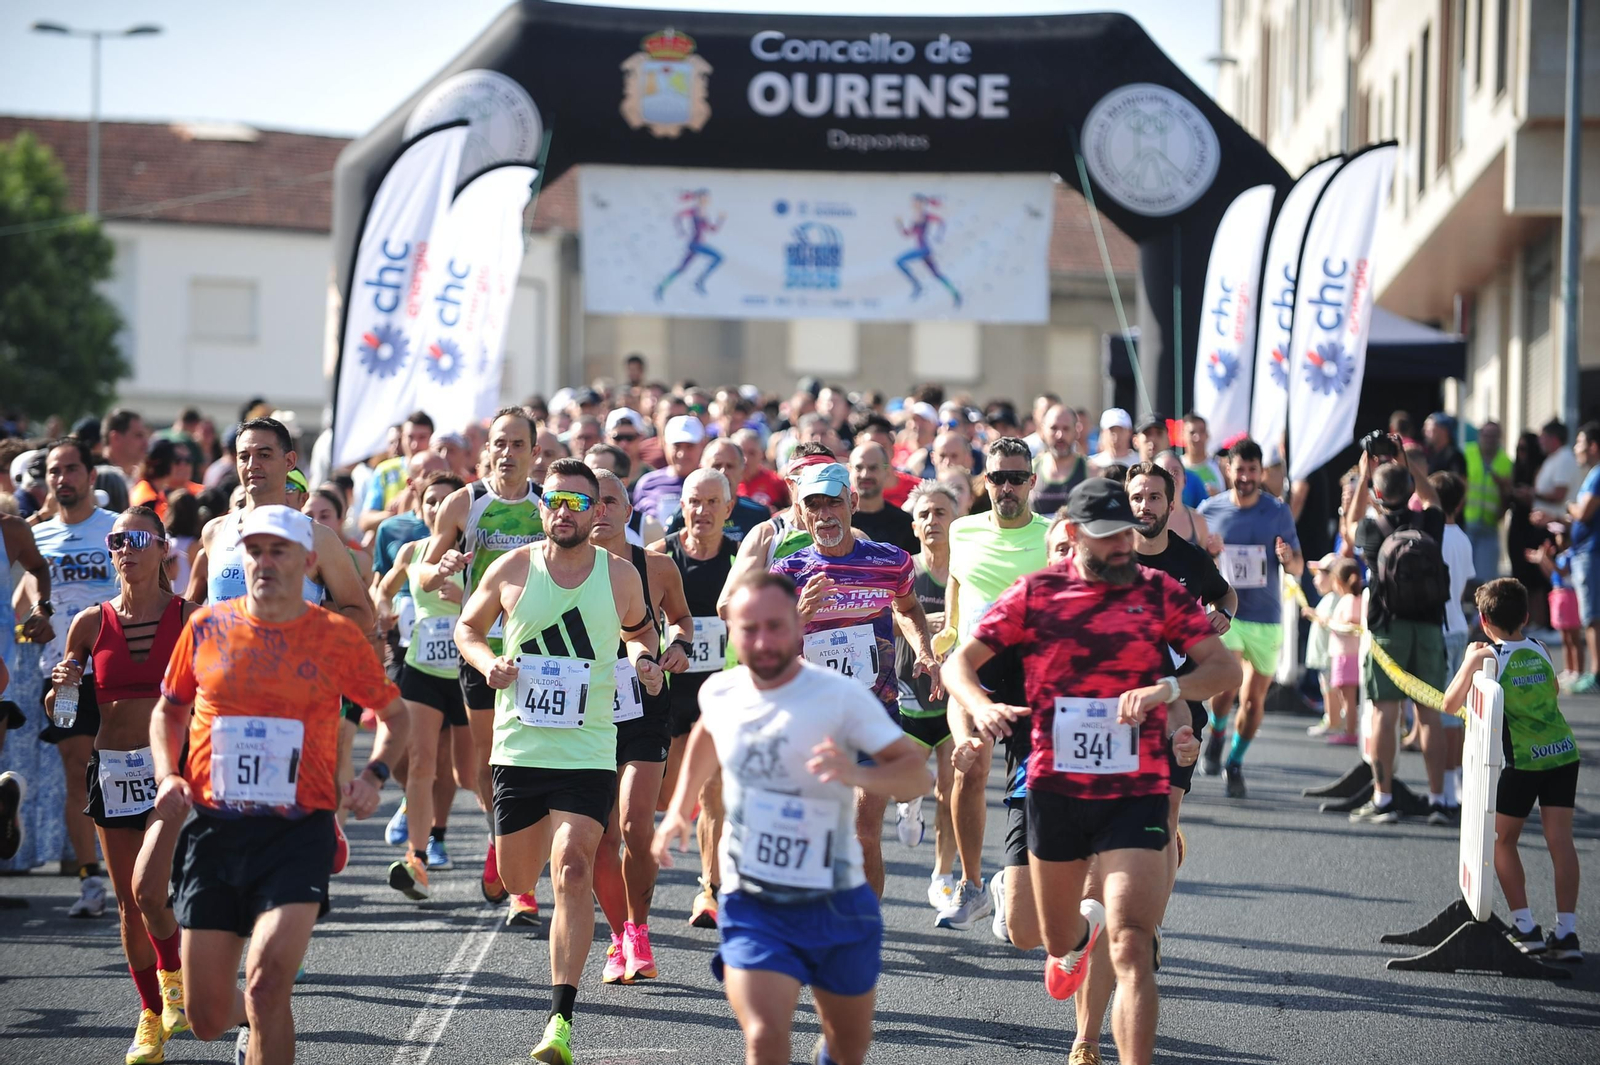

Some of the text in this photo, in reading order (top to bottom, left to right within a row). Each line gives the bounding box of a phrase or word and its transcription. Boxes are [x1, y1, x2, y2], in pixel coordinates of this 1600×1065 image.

[751, 30, 972, 64] Concello de
[747, 71, 1010, 119] OURENSE
[826, 128, 930, 153] Deportes
[365, 239, 411, 313] chc
[435, 257, 471, 327] chc
[1308, 257, 1347, 330] chc
[1211, 277, 1233, 336] chc
[62, 566, 107, 581] RUN
[1235, 563, 1248, 580] 21
[848, 589, 889, 600] TRAIL
[426, 640, 459, 661] 336
[820, 646, 855, 657] ATEGA XXI
[529, 677, 563, 687] JULIOPOL
[524, 688, 566, 716] 449
[1074, 732, 1113, 760] 341
[237, 755, 260, 785] 51
[114, 777, 158, 804] 763
[757, 833, 810, 869] 687
